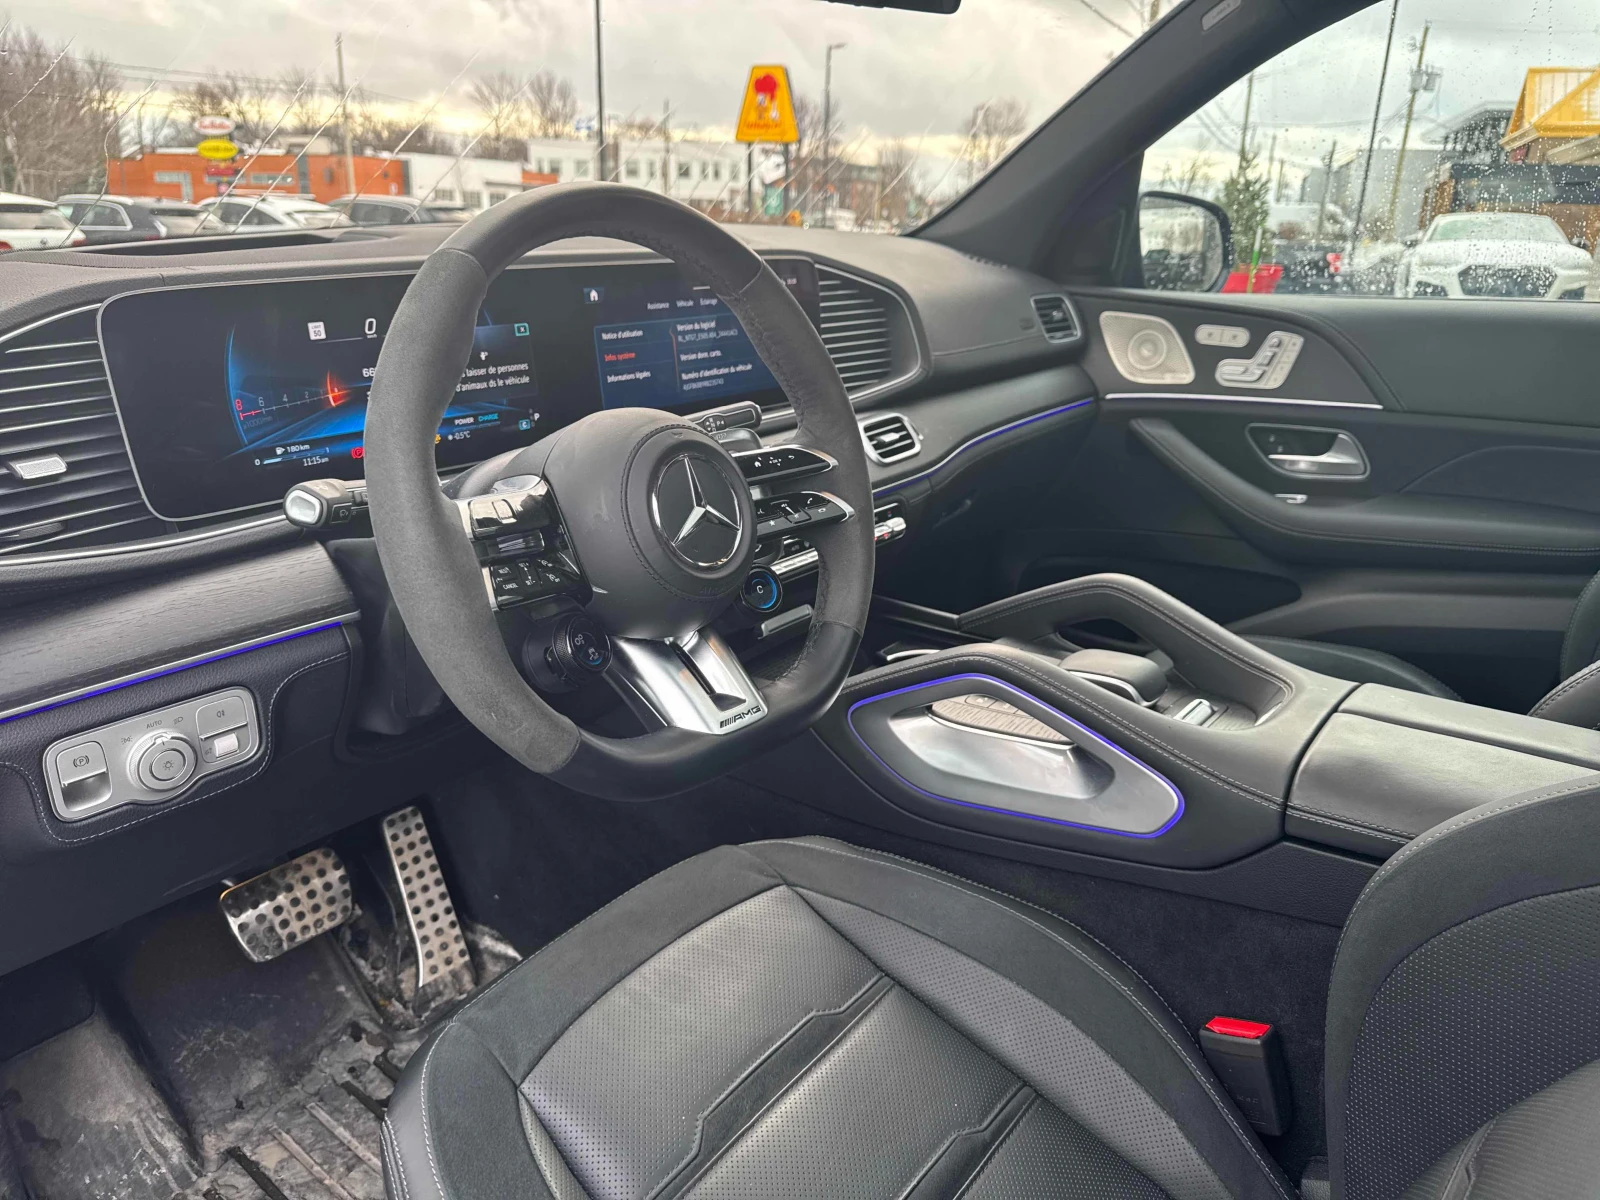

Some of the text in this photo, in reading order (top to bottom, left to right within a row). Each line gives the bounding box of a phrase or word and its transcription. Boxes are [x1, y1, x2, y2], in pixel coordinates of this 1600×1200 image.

[364, 317, 377, 334] 0
[313, 329, 322, 337] 50
[466, 367, 487, 377] laisser
[488, 365, 496, 374] de
[497, 363, 529, 375] personnes
[497, 378, 504, 387] le
[235, 398, 243, 411] 8
[258, 396, 265, 407] 6
[282, 394, 288, 402] 4
[534, 412, 540, 421] P
[286, 445, 299, 454] 180
[756, 585, 764, 594] C
[146, 719, 163, 730] AUTO
